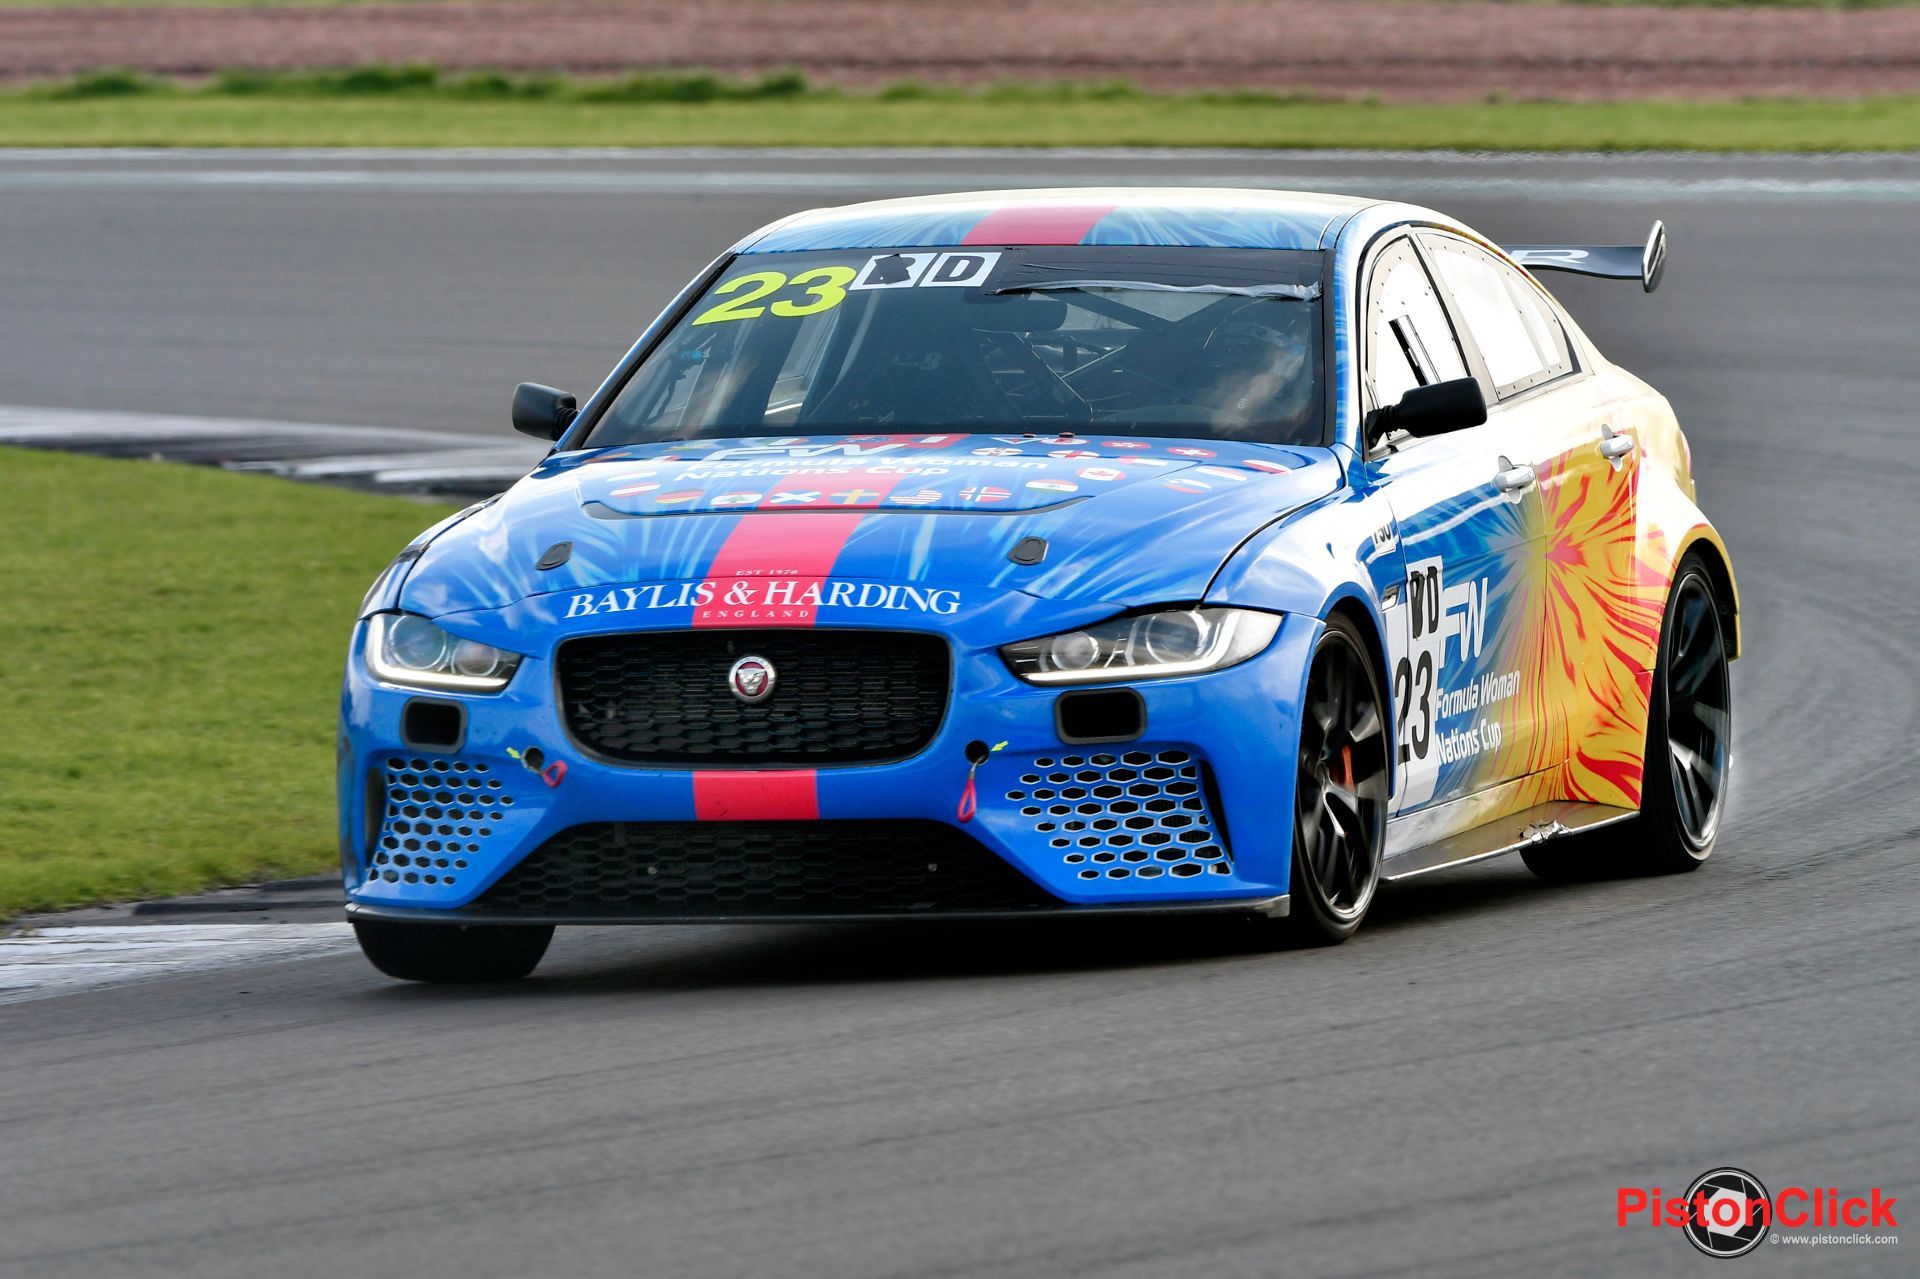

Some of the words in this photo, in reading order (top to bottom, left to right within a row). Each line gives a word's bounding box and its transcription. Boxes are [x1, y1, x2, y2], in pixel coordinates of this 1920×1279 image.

[692, 266, 857, 325] 23
[674, 465, 849, 481] Nations
[864, 465, 950, 476] Cup
[687, 457, 868, 471] Formula
[880, 456, 1049, 470] Woman
[701, 443, 912, 462] FW
[563, 582, 714, 619] BAYLIS
[723, 579, 759, 607] &
[761, 580, 961, 615] HARDING
[702, 609, 809, 619] ENGLAND
[1438, 577, 1488, 669] FW
[1394, 650, 1433, 766] 23
[1435, 677, 1479, 722] Formula
[1480, 669, 1521, 704] Woman
[1435, 726, 1480, 766] Nations
[1480, 717, 1502, 753] Cup
